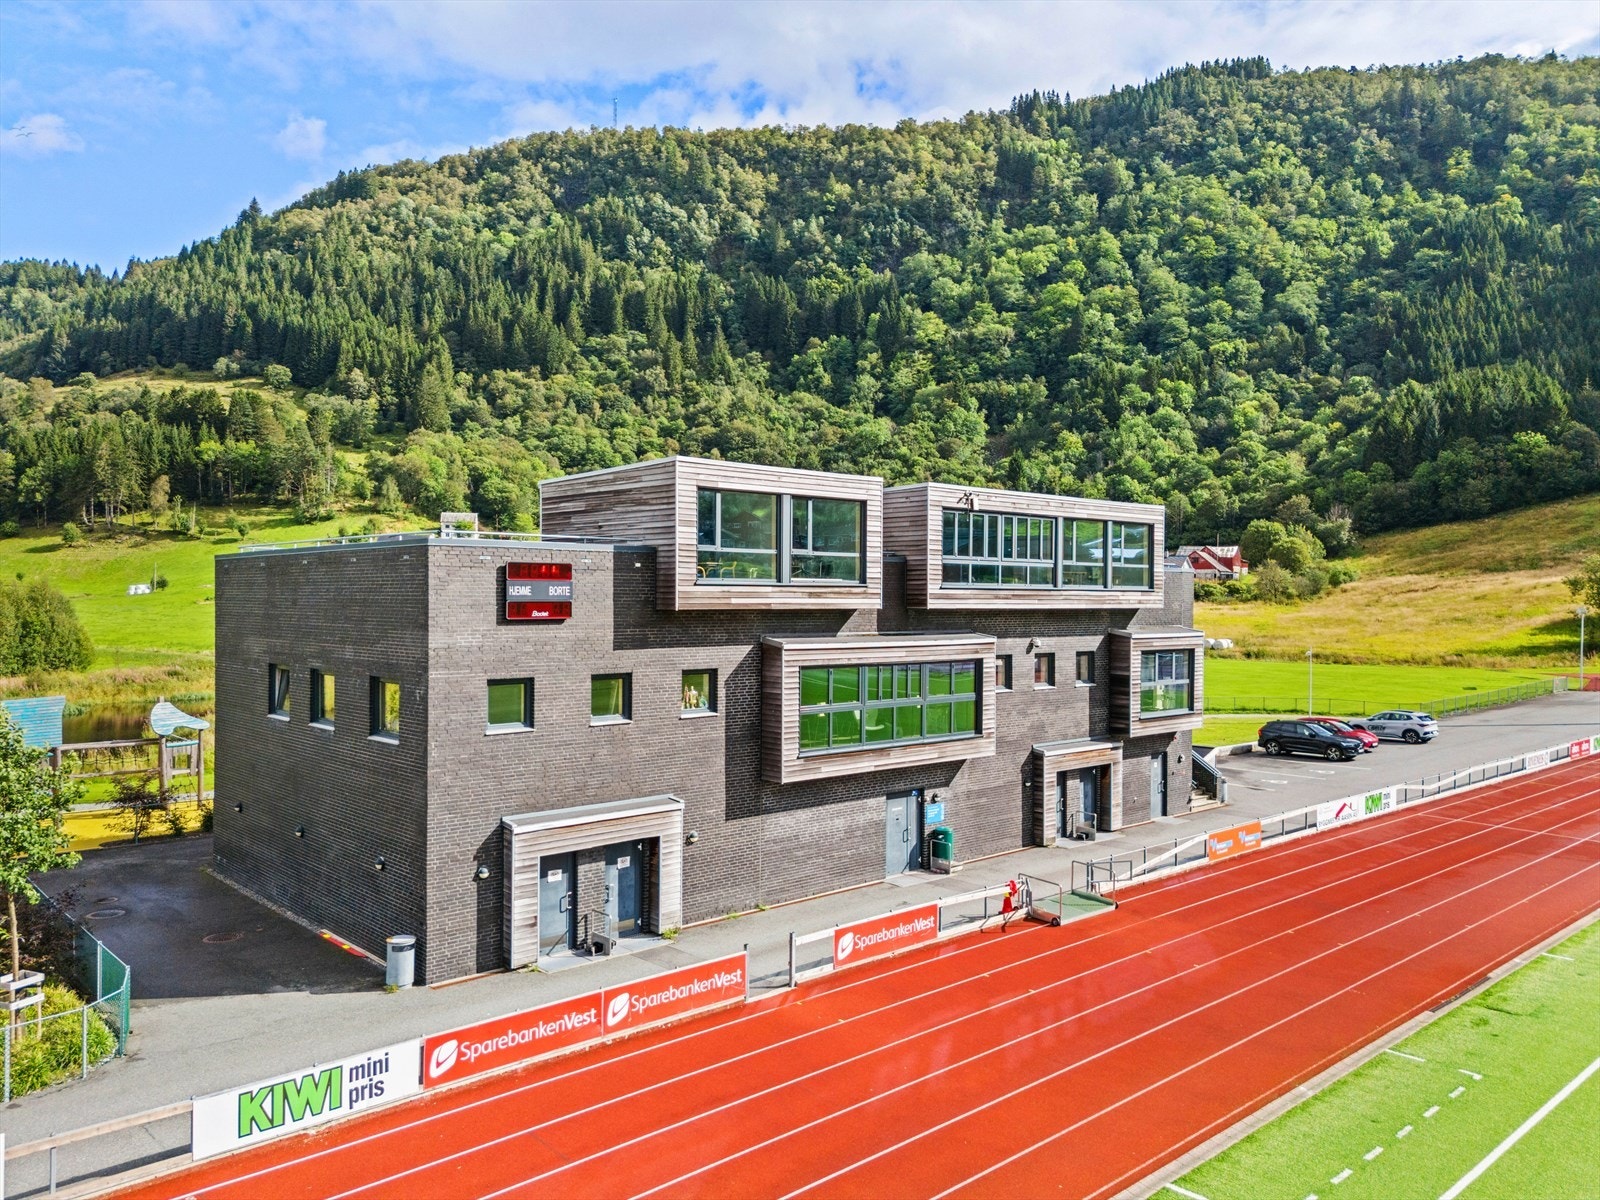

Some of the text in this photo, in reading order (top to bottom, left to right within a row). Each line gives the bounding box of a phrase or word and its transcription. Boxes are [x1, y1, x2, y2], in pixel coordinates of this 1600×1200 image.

[509, 586, 571, 596] HJEMME BORTE
[1365, 792, 1382, 814] KIWI
[349, 1052, 389, 1083] mini
[238, 1065, 343, 1138] KIWI
[349, 1078, 385, 1110] pris
